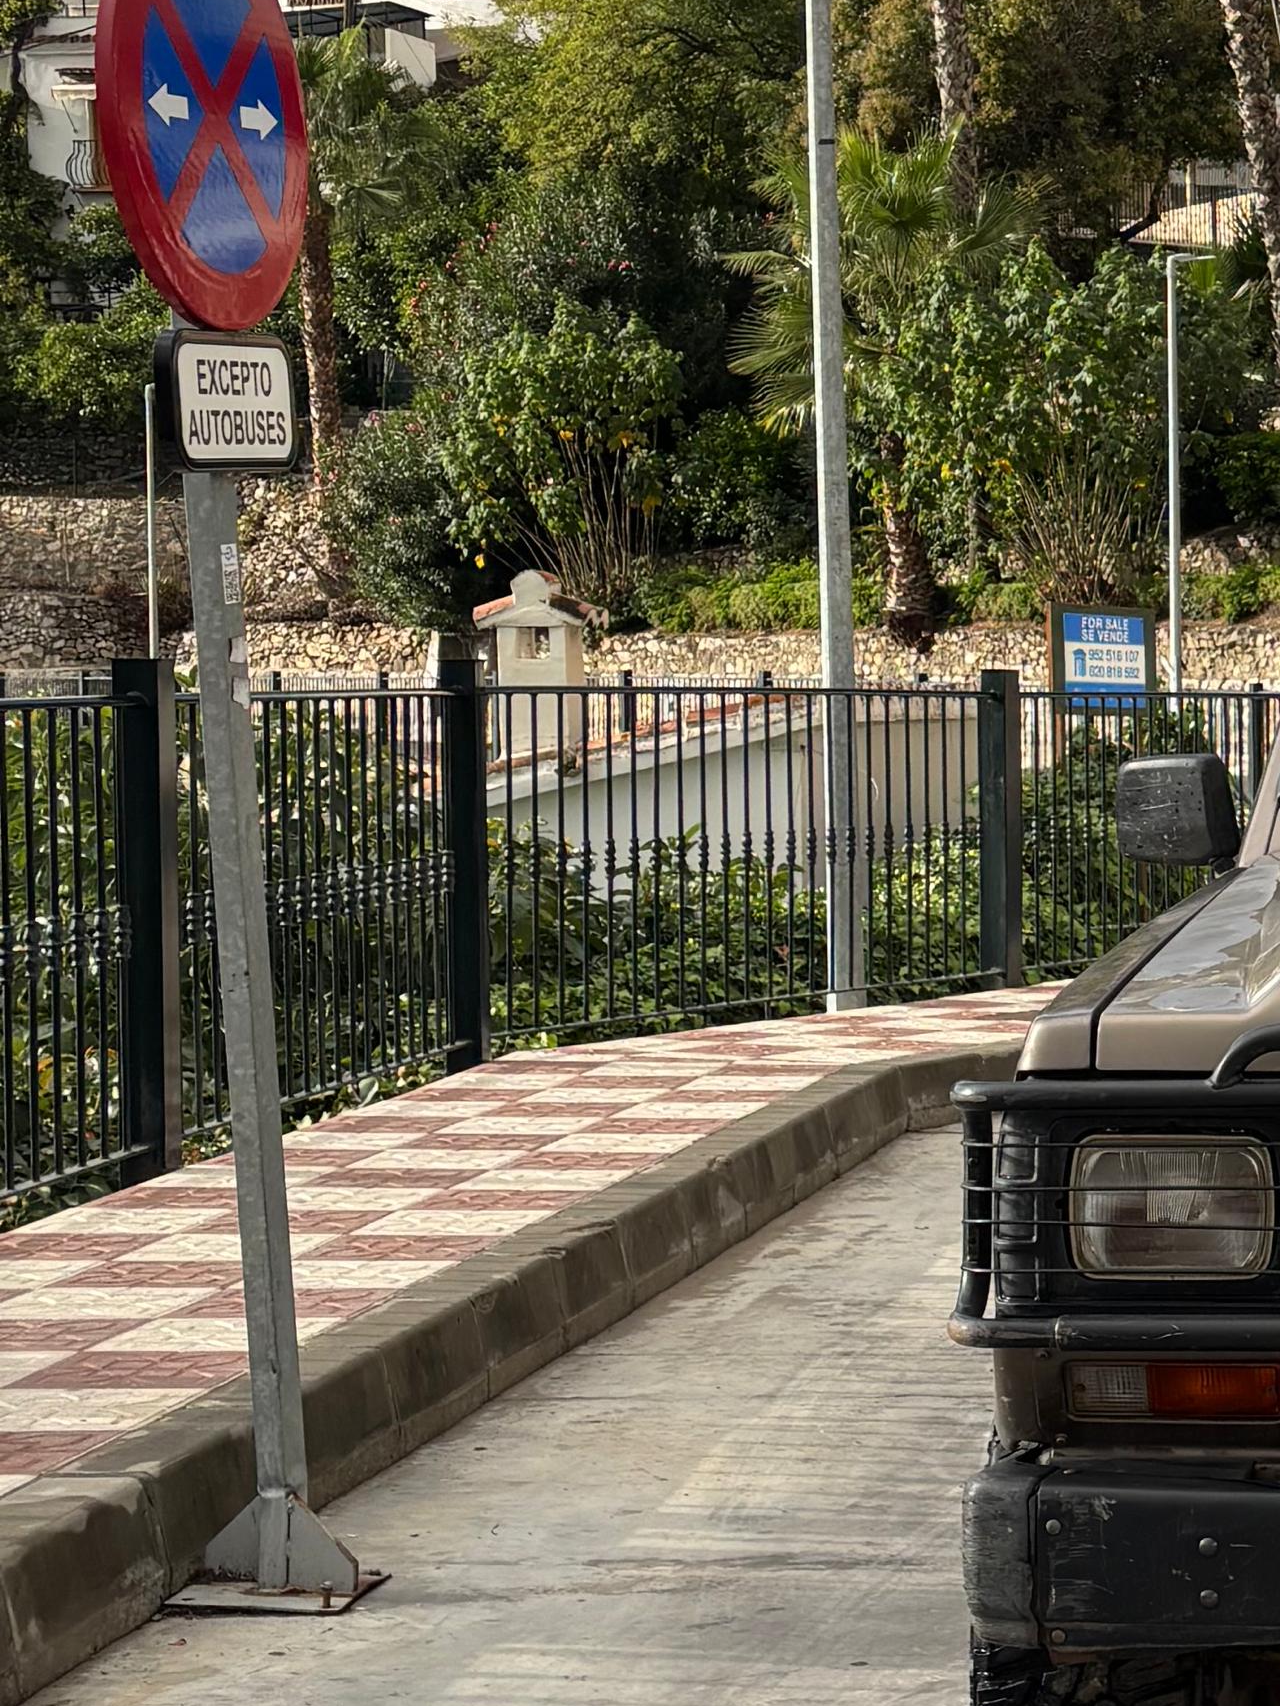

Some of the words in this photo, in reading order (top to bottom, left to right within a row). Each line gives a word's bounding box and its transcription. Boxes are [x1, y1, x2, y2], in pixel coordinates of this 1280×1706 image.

[196, 359, 272, 397] EXCEPTO
[188, 409, 287, 446] AUTOBUSES
[1081, 616, 1103, 630] FOR
[1105, 618, 1129, 631] SALE
[1081, 629, 1094, 641] SE
[1097, 630, 1129, 643] VENDE
